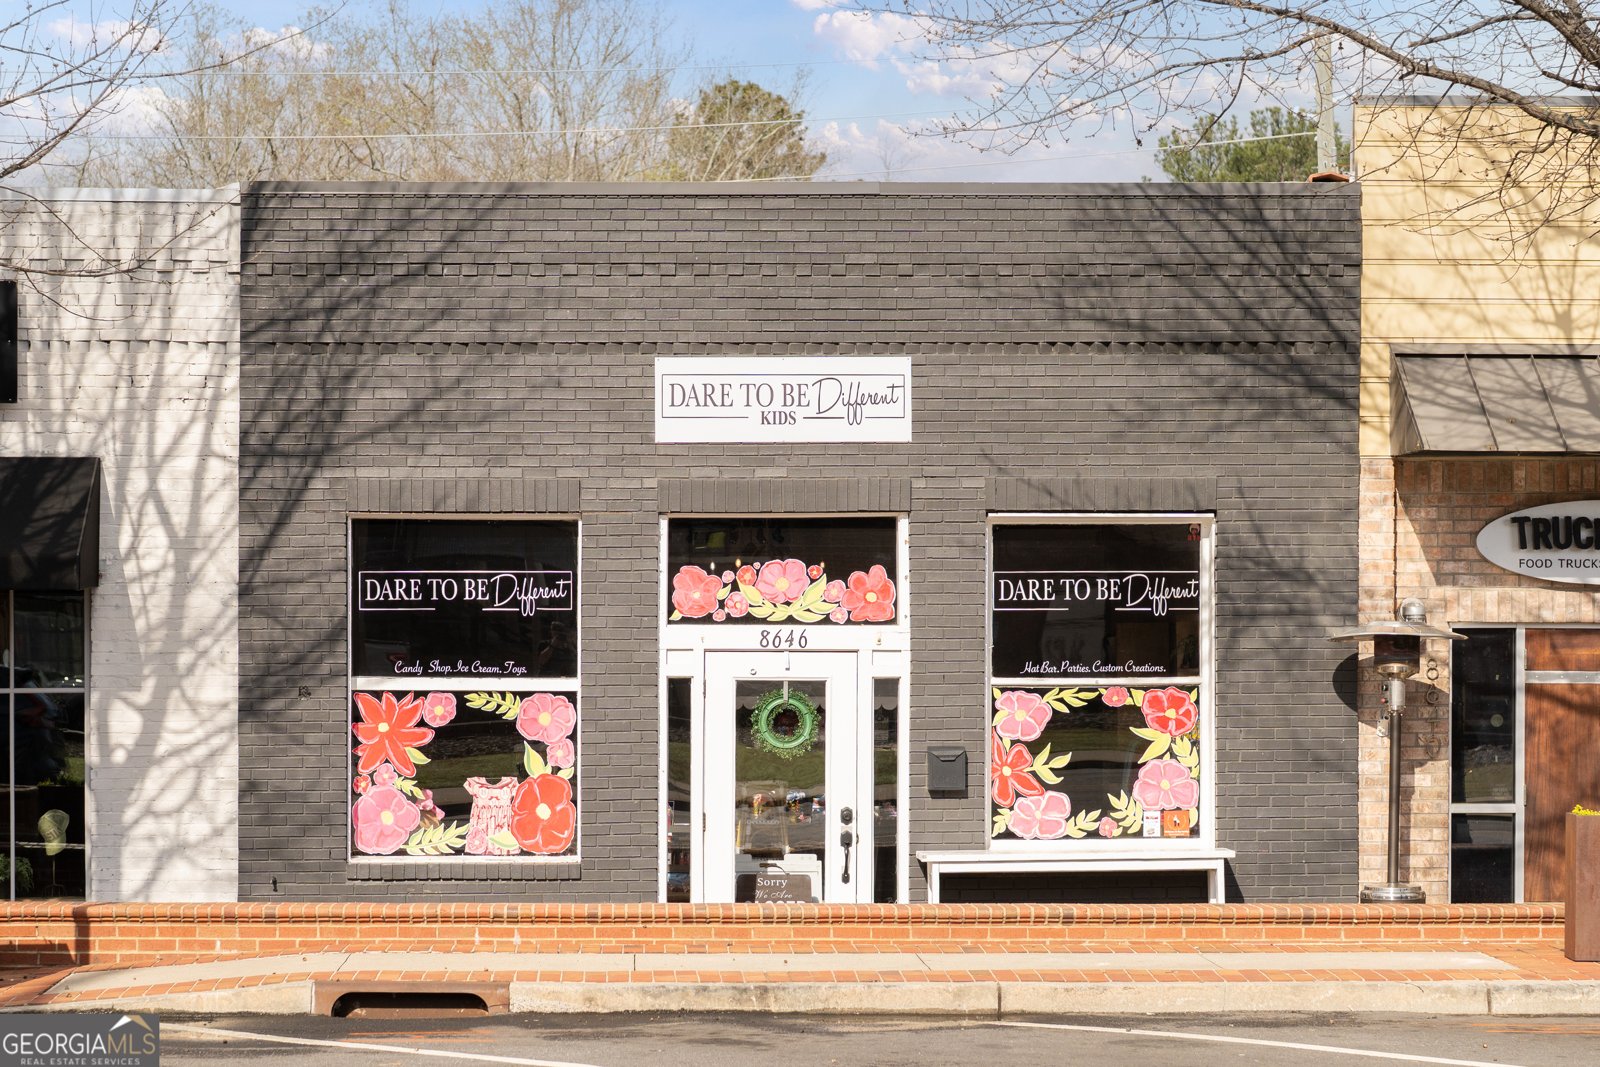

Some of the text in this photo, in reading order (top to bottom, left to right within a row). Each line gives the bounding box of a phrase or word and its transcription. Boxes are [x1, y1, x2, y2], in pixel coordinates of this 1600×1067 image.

[669, 377, 904, 426] DARE TO BE Different
[760, 411, 797, 425] KIDS
[1519, 559, 1600, 568] FOOD TRUCK
[365, 573, 571, 617] DARE TO BE Different
[999, 573, 1199, 616] DARE TO BE Different
[759, 629, 808, 649] 8646
[394, 660, 527, 676] Candy Shop. Ice Cream. Toys.
[1020, 660, 1166, 674] Hat Bar. Parties. Custom Creations.
[757, 877, 788, 888] Sorry
[755, 889, 793, 898] We Are
